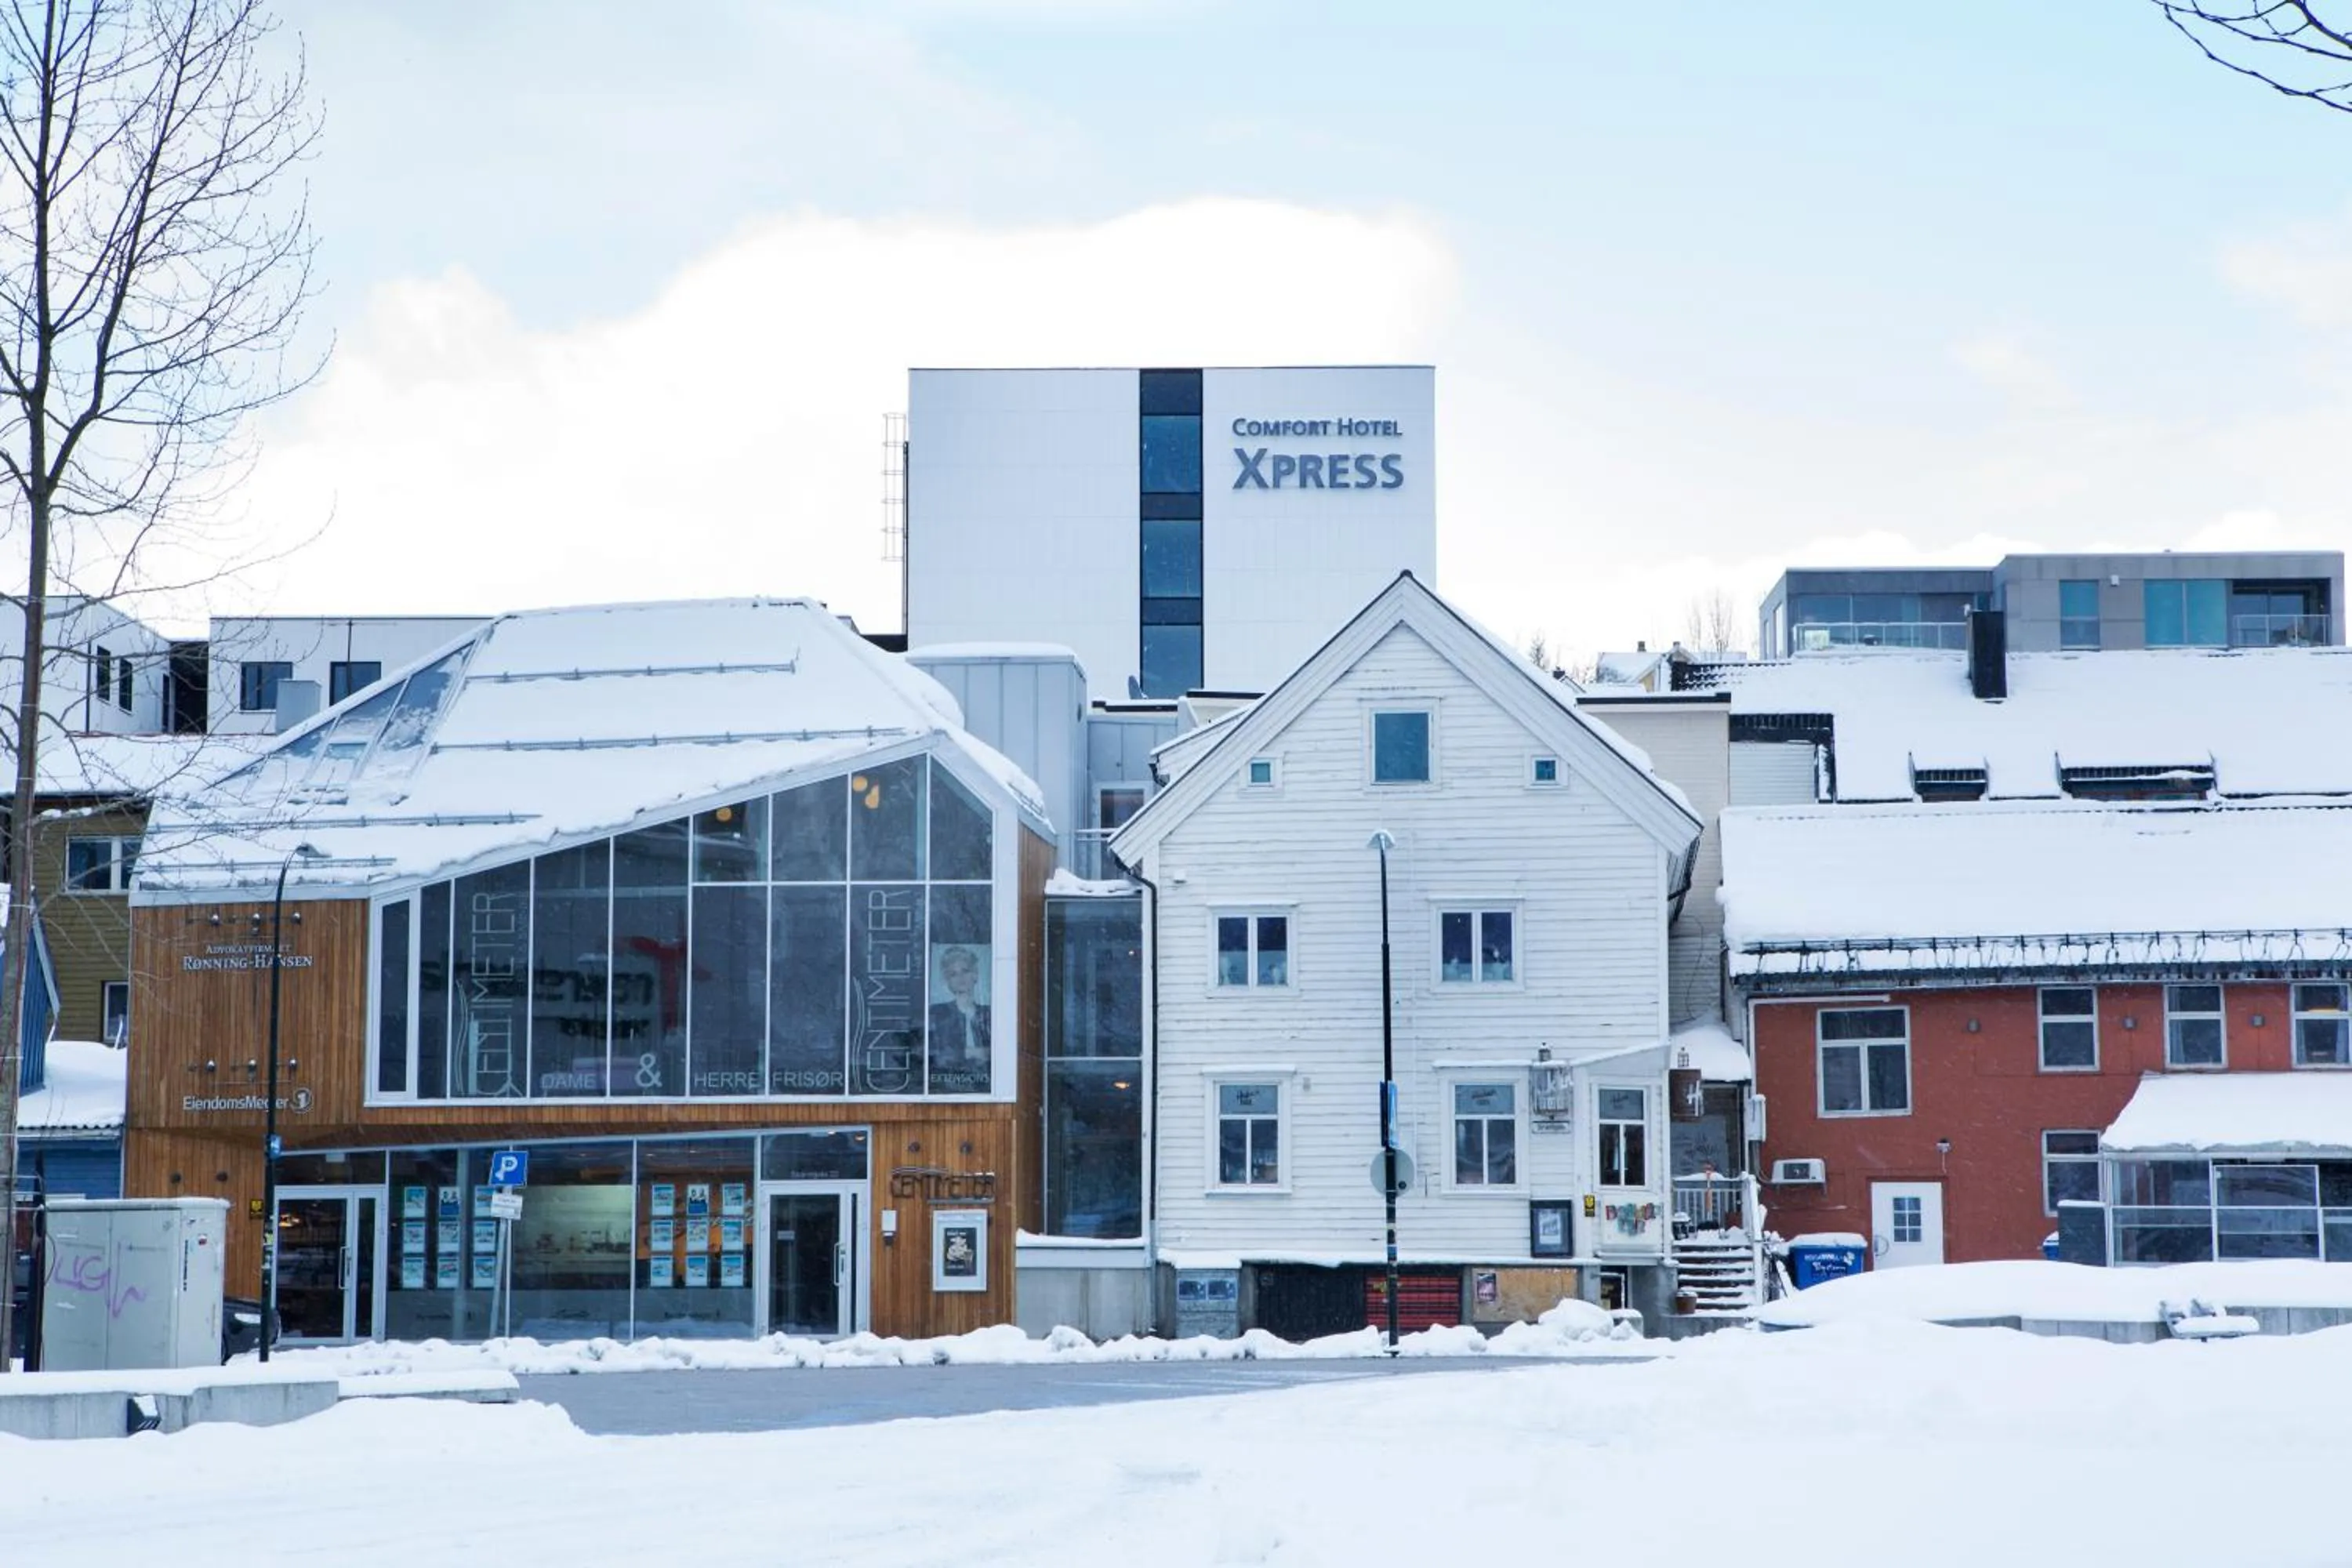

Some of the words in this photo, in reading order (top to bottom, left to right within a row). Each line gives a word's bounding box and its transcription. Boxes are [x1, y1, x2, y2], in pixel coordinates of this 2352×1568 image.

[1232, 418, 1331, 437] COMFORT
[1337, 418, 1403, 437] HOTEL
[1232, 448, 1404, 490] XPRESS
[205, 944, 292, 954] ADVOKATFIRMET
[866, 890, 911, 1092] CENTIMETER
[541, 1073, 596, 1090] DAME
[634, 1053, 662, 1087] &
[694, 1072, 760, 1088] HERRE
[772, 1072, 844, 1088] FRISØR
